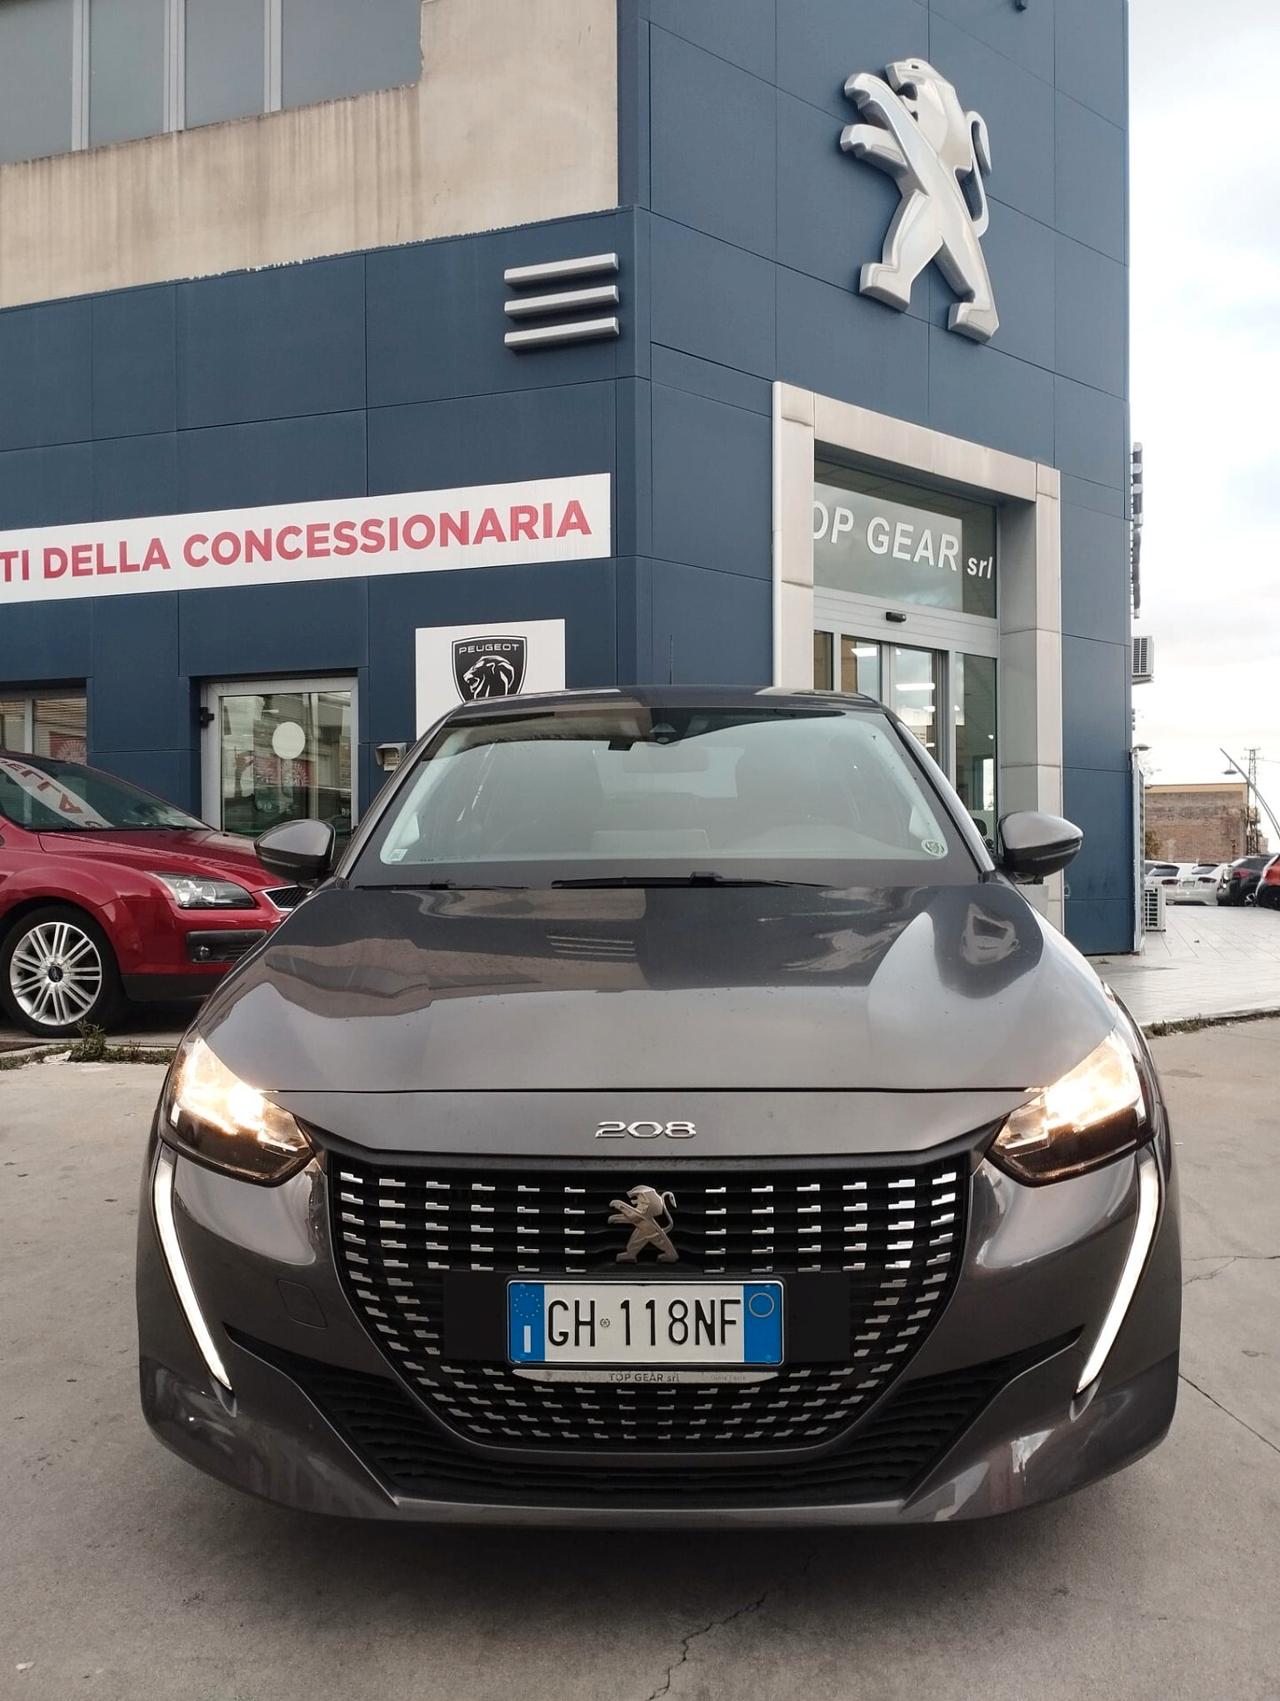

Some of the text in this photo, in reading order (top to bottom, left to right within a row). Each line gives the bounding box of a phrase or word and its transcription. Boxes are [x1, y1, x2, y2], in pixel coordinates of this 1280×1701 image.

[43, 538, 171, 579] DELLA
[183, 500, 592, 568] CONCESSIONARIA
[866, 516, 960, 572] GEAR
[966, 556, 993, 579] srl
[458, 643, 520, 654] PEUGEOT
[595, 1121, 697, 1139] 208
[548, 1299, 741, 1347] GH 118NF
[608, 1373, 631, 1382] TOP
[634, 1373, 663, 1382] GEAR
